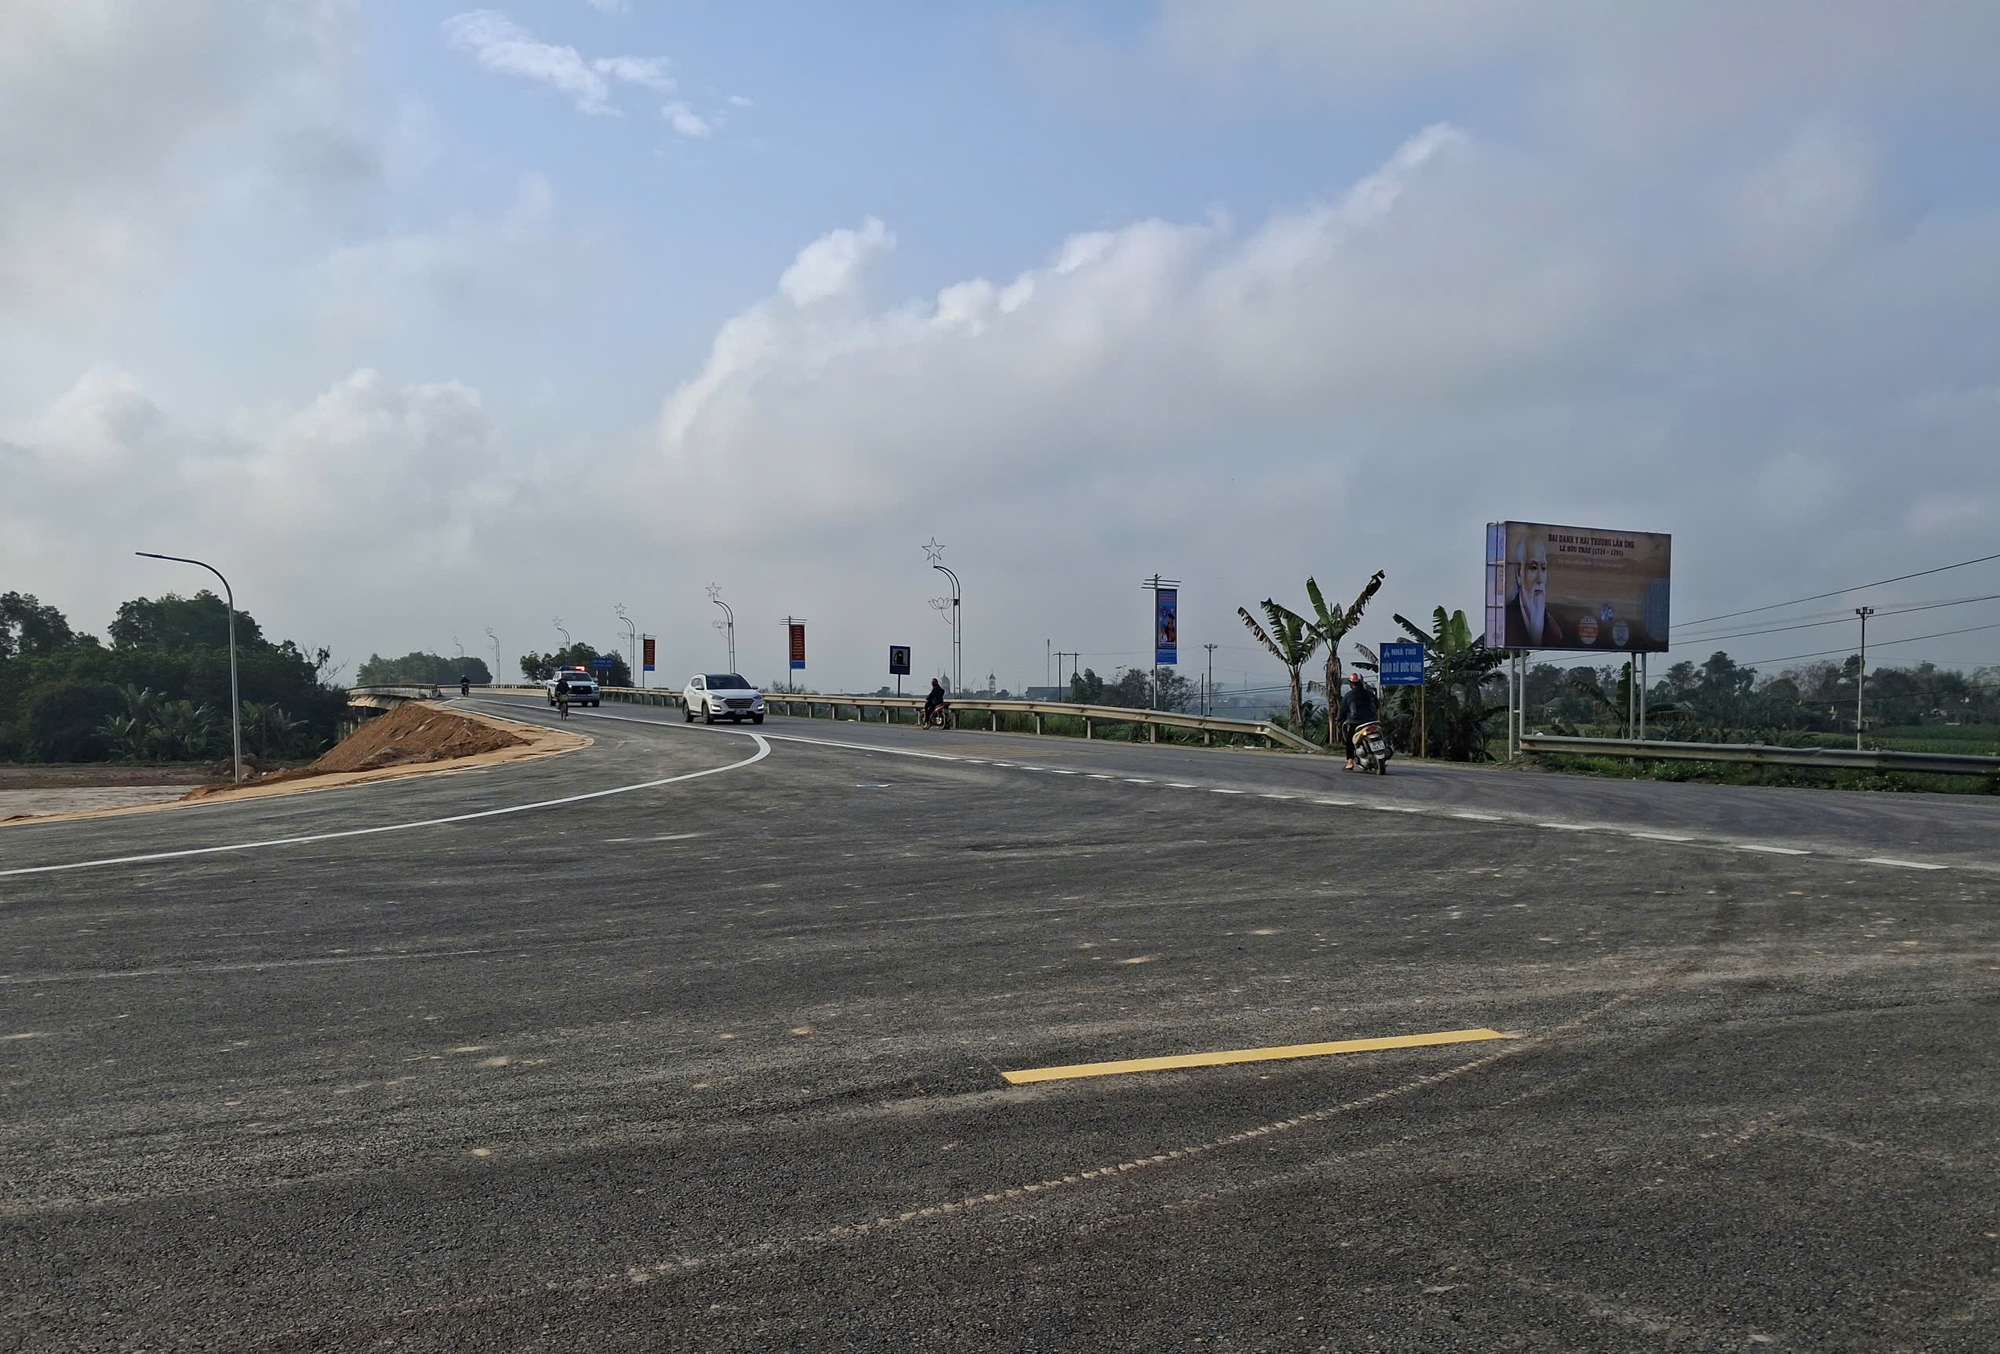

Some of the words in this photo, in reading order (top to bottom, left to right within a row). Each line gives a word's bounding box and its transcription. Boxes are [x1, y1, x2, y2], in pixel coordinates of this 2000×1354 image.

[1559, 534, 1574, 543] DANH
[1575, 536, 1579, 544] Y
[1391, 648, 1404, 656] NHÀ
